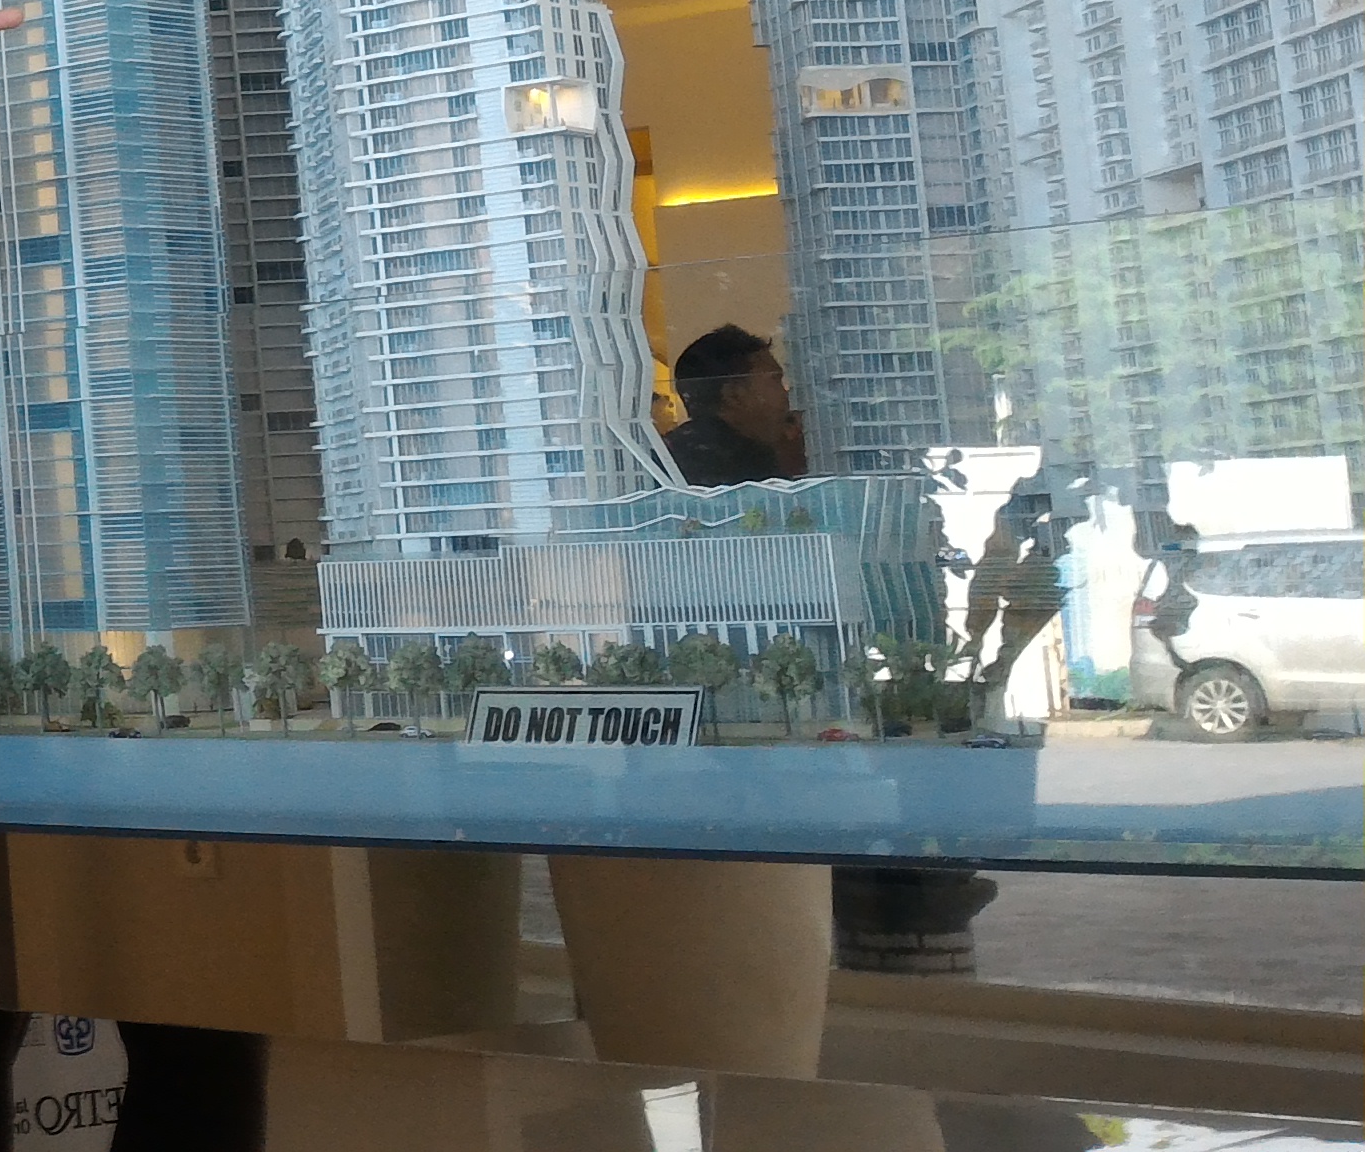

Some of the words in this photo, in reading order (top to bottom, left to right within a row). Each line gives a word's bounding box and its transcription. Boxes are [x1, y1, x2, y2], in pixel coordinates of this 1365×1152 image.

[482, 706, 521, 743] DO
[525, 706, 580, 745] NOT
[588, 706, 684, 746] TOUCH
